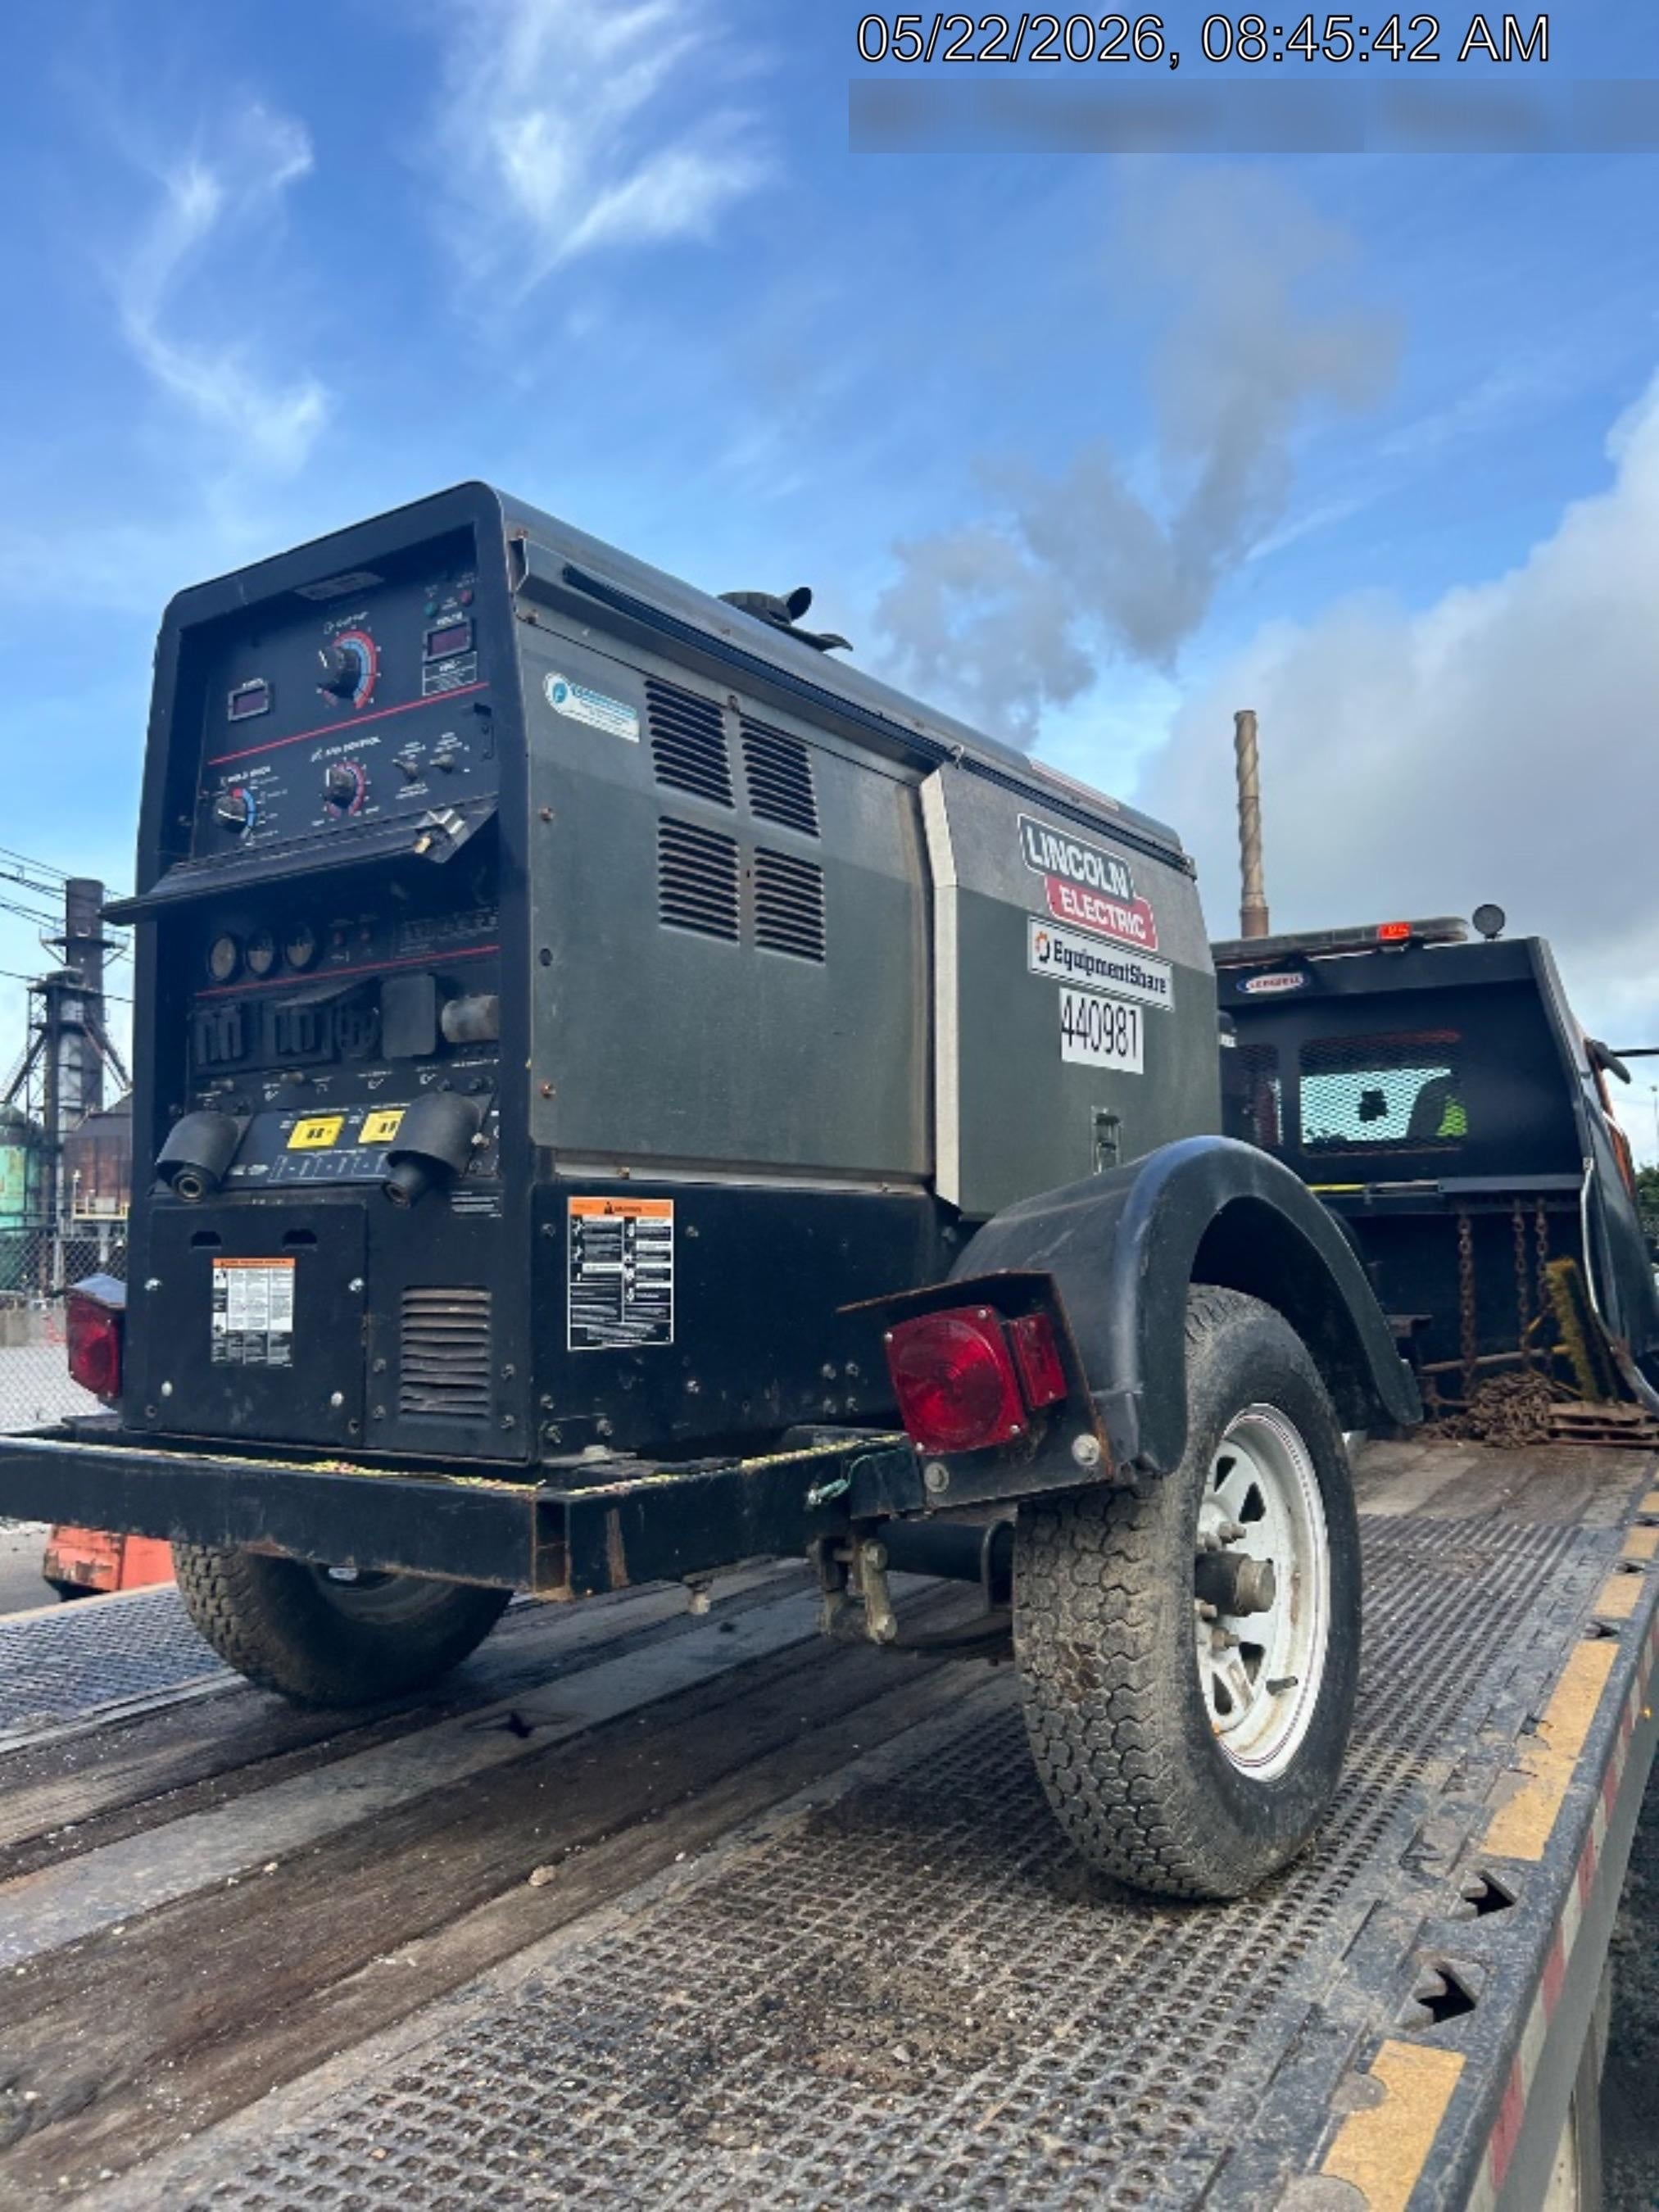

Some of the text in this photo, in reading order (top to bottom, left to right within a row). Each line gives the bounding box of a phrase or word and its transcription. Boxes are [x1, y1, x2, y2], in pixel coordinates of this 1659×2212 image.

[1027, 825, 1129, 900] LINCOLN
[1058, 885, 1146, 940] ELECTRIC
[1054, 939, 1167, 994] EquipmentShare
[1061, 994, 1137, 1059] 440981
